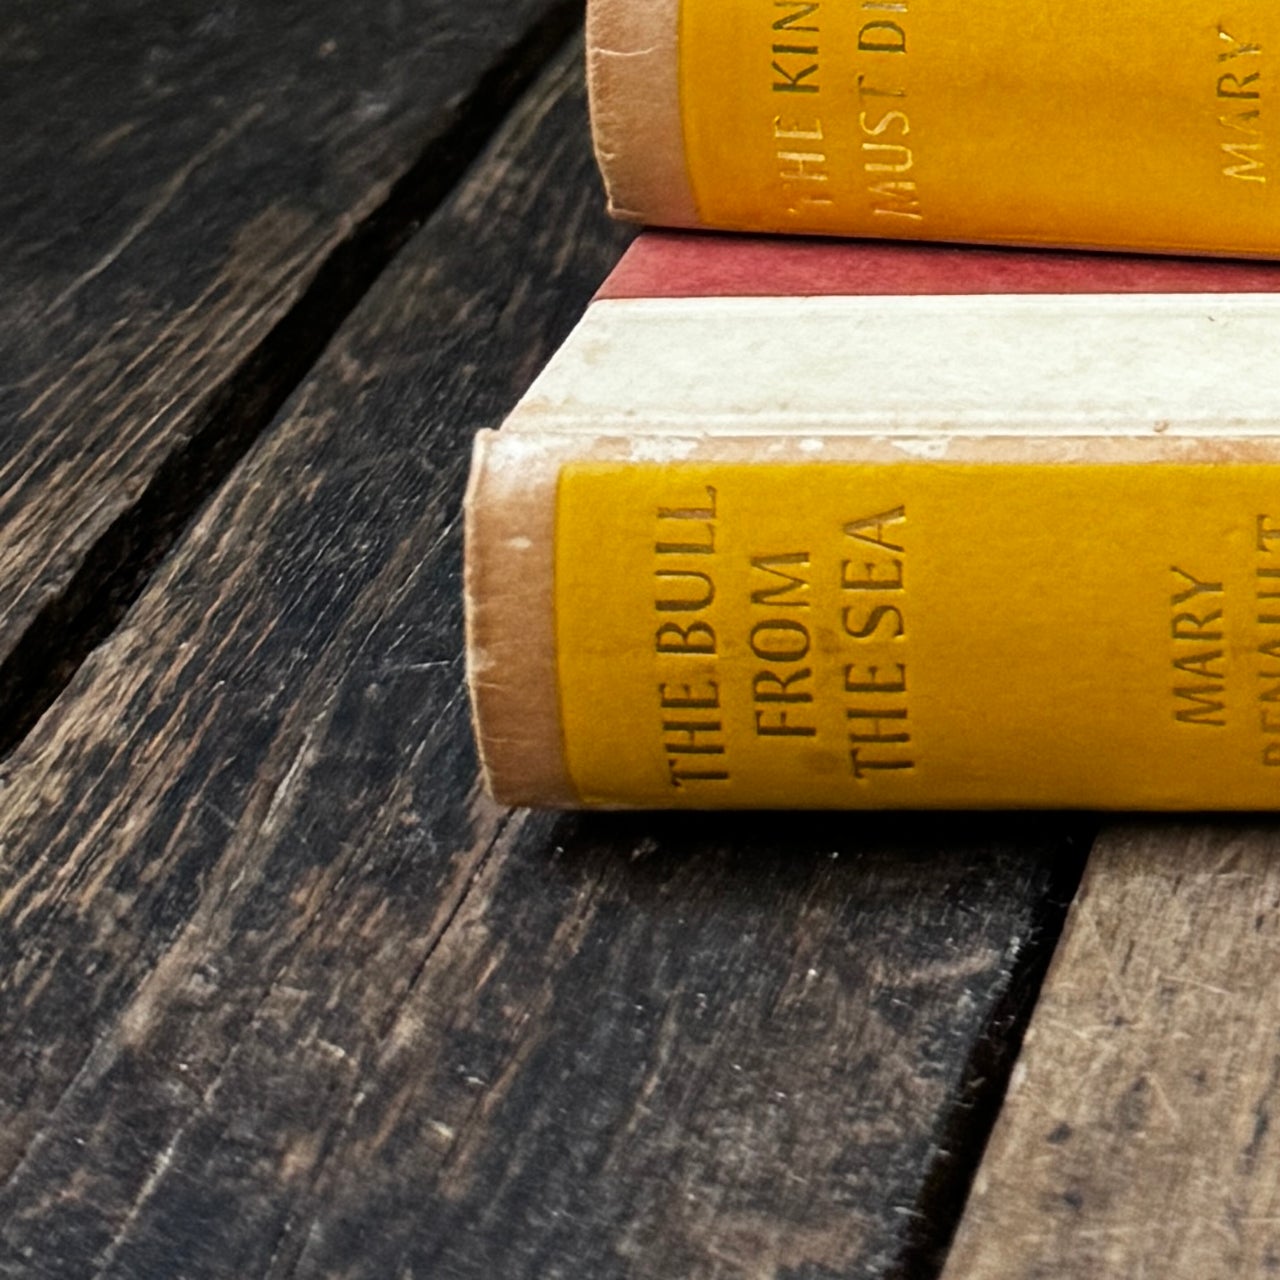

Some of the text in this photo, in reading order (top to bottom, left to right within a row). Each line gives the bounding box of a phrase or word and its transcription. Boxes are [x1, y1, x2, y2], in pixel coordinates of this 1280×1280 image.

[774, 114, 832, 214] THE
[857, 73, 923, 221] MUST
[1217, 26, 1266, 184] MARY
[654, 484, 731, 789] THE BULL
[749, 551, 817, 739] FROM
[841, 504, 915, 780] THE SEA
[1170, 565, 1226, 727] MARY
